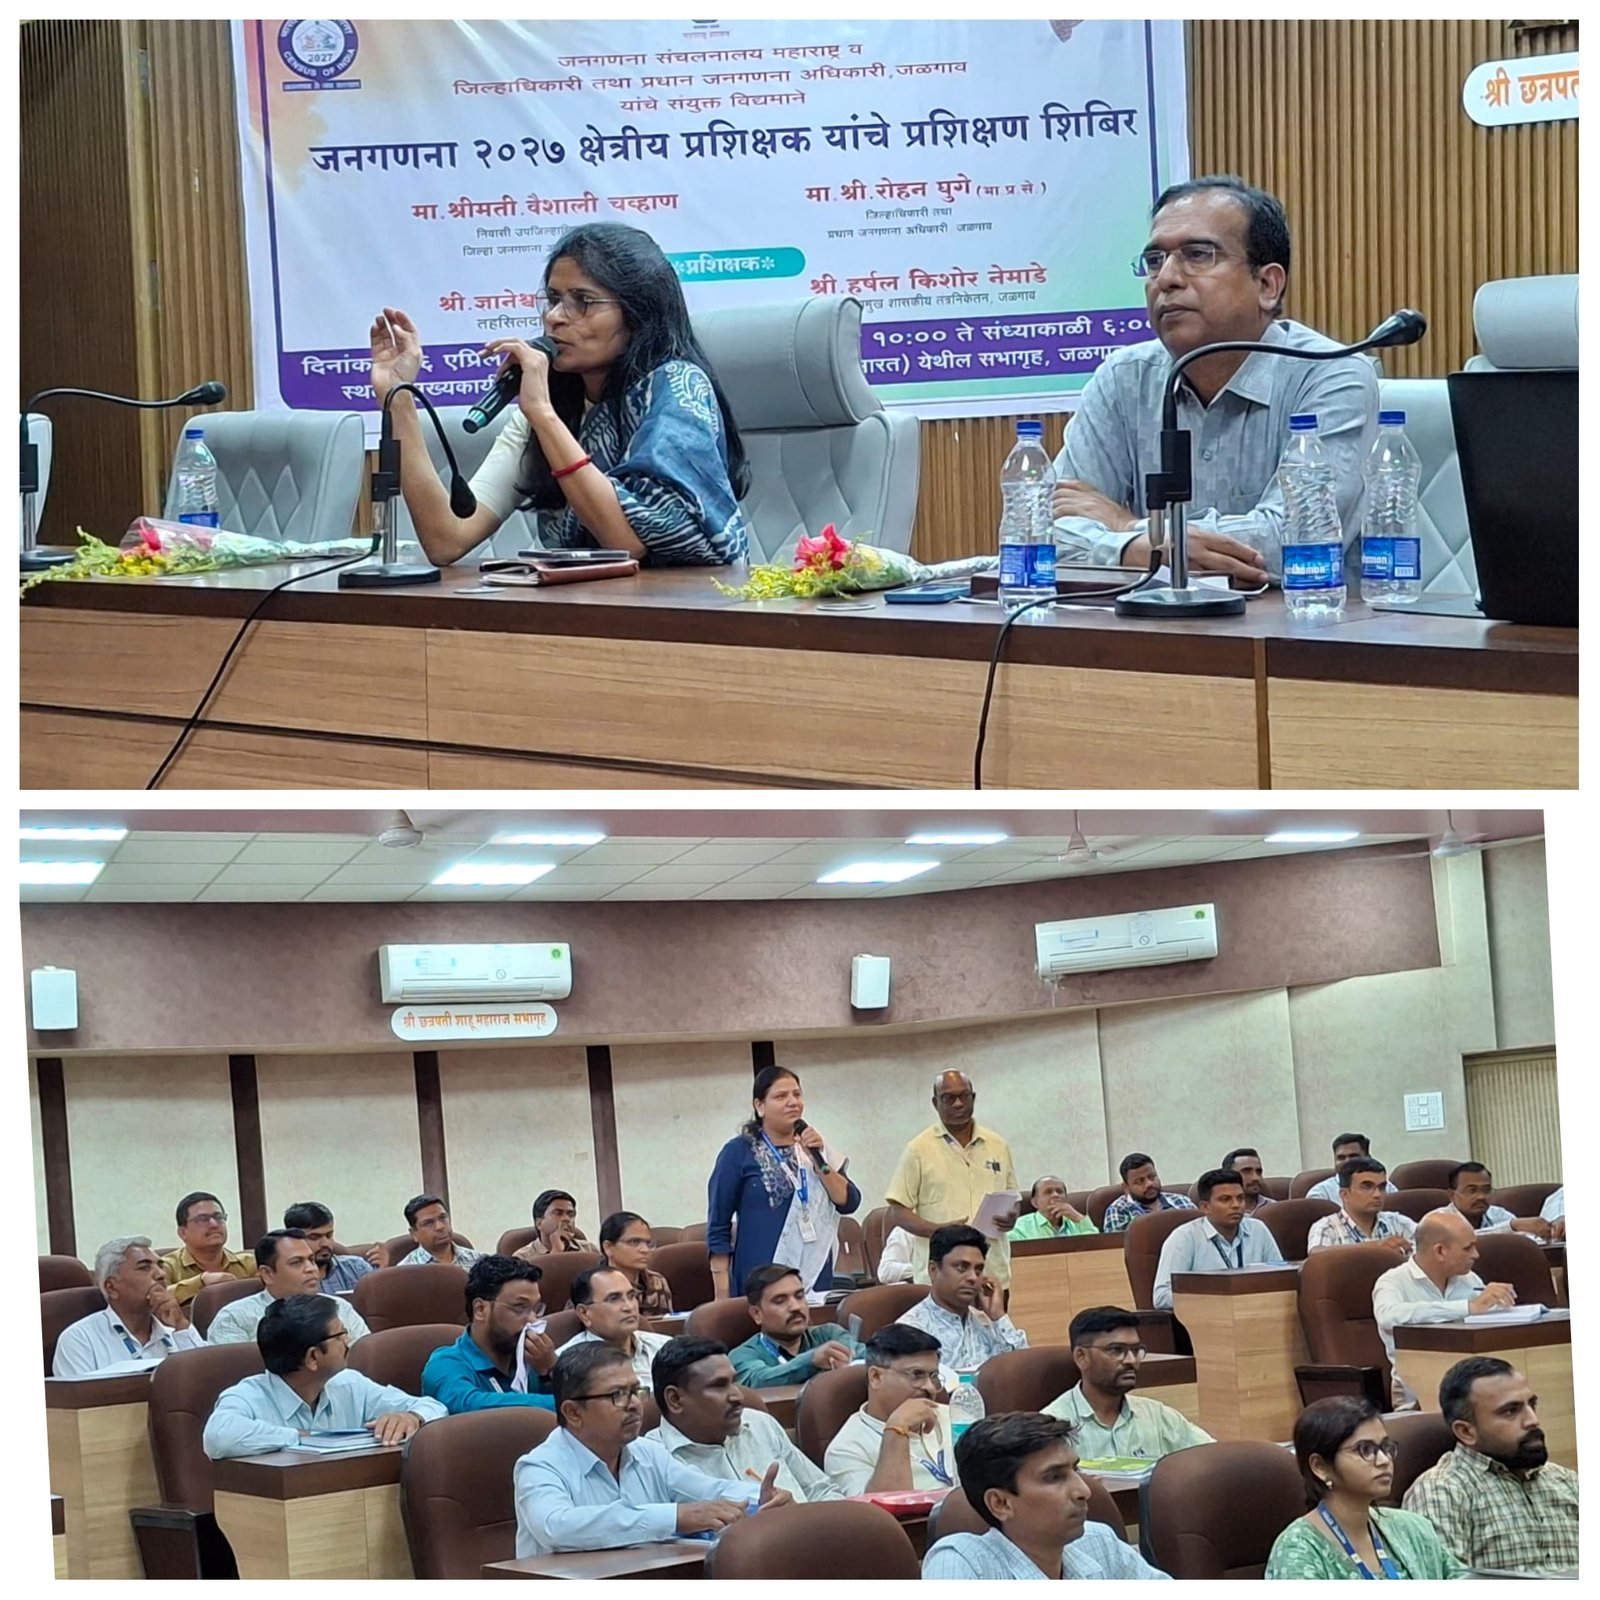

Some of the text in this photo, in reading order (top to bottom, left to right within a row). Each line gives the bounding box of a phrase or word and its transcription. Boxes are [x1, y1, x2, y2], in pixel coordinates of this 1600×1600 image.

[283, 49, 356, 77] CENSUS OF INDIA
[308, 53, 333, 63] 2027
[558, 44, 863, 68] जनगणना संचलनालय महाराष्ट्र व
[452, 75, 583, 95] जिल्हाधिकारी
[592, 77, 632, 90] तथा
[641, 75, 693, 88] प्रधान
[702, 70, 790, 85] जनगणना
[1484, 66, 1511, 108] श्री
[620, 89, 806, 113] यांचे संयुक्त विद्यमाने
[309, 98, 1138, 174] जनगणना २०२७ क्षेत्रीय प्रशिक्षक यांचे प्रशिक्षण शिबिर
[936, 172, 972, 203] घुगे
[607, 193, 679, 214] चव्हाण
[858, 227, 901, 237] जनगणना
[497, 244, 542, 255] जनगणना
[908, 266, 979, 290] किशोर
[987, 261, 1048, 286] नेमाडे
[476, 313, 542, 330] तहसिलदा
[872, 329, 948, 347] १०:००
[955, 322, 975, 342] ते
[981, 315, 1093, 341] संध्याकाळी
[918, 350, 971, 371] येथील
[978, 348, 1051, 371] सभागृह,
